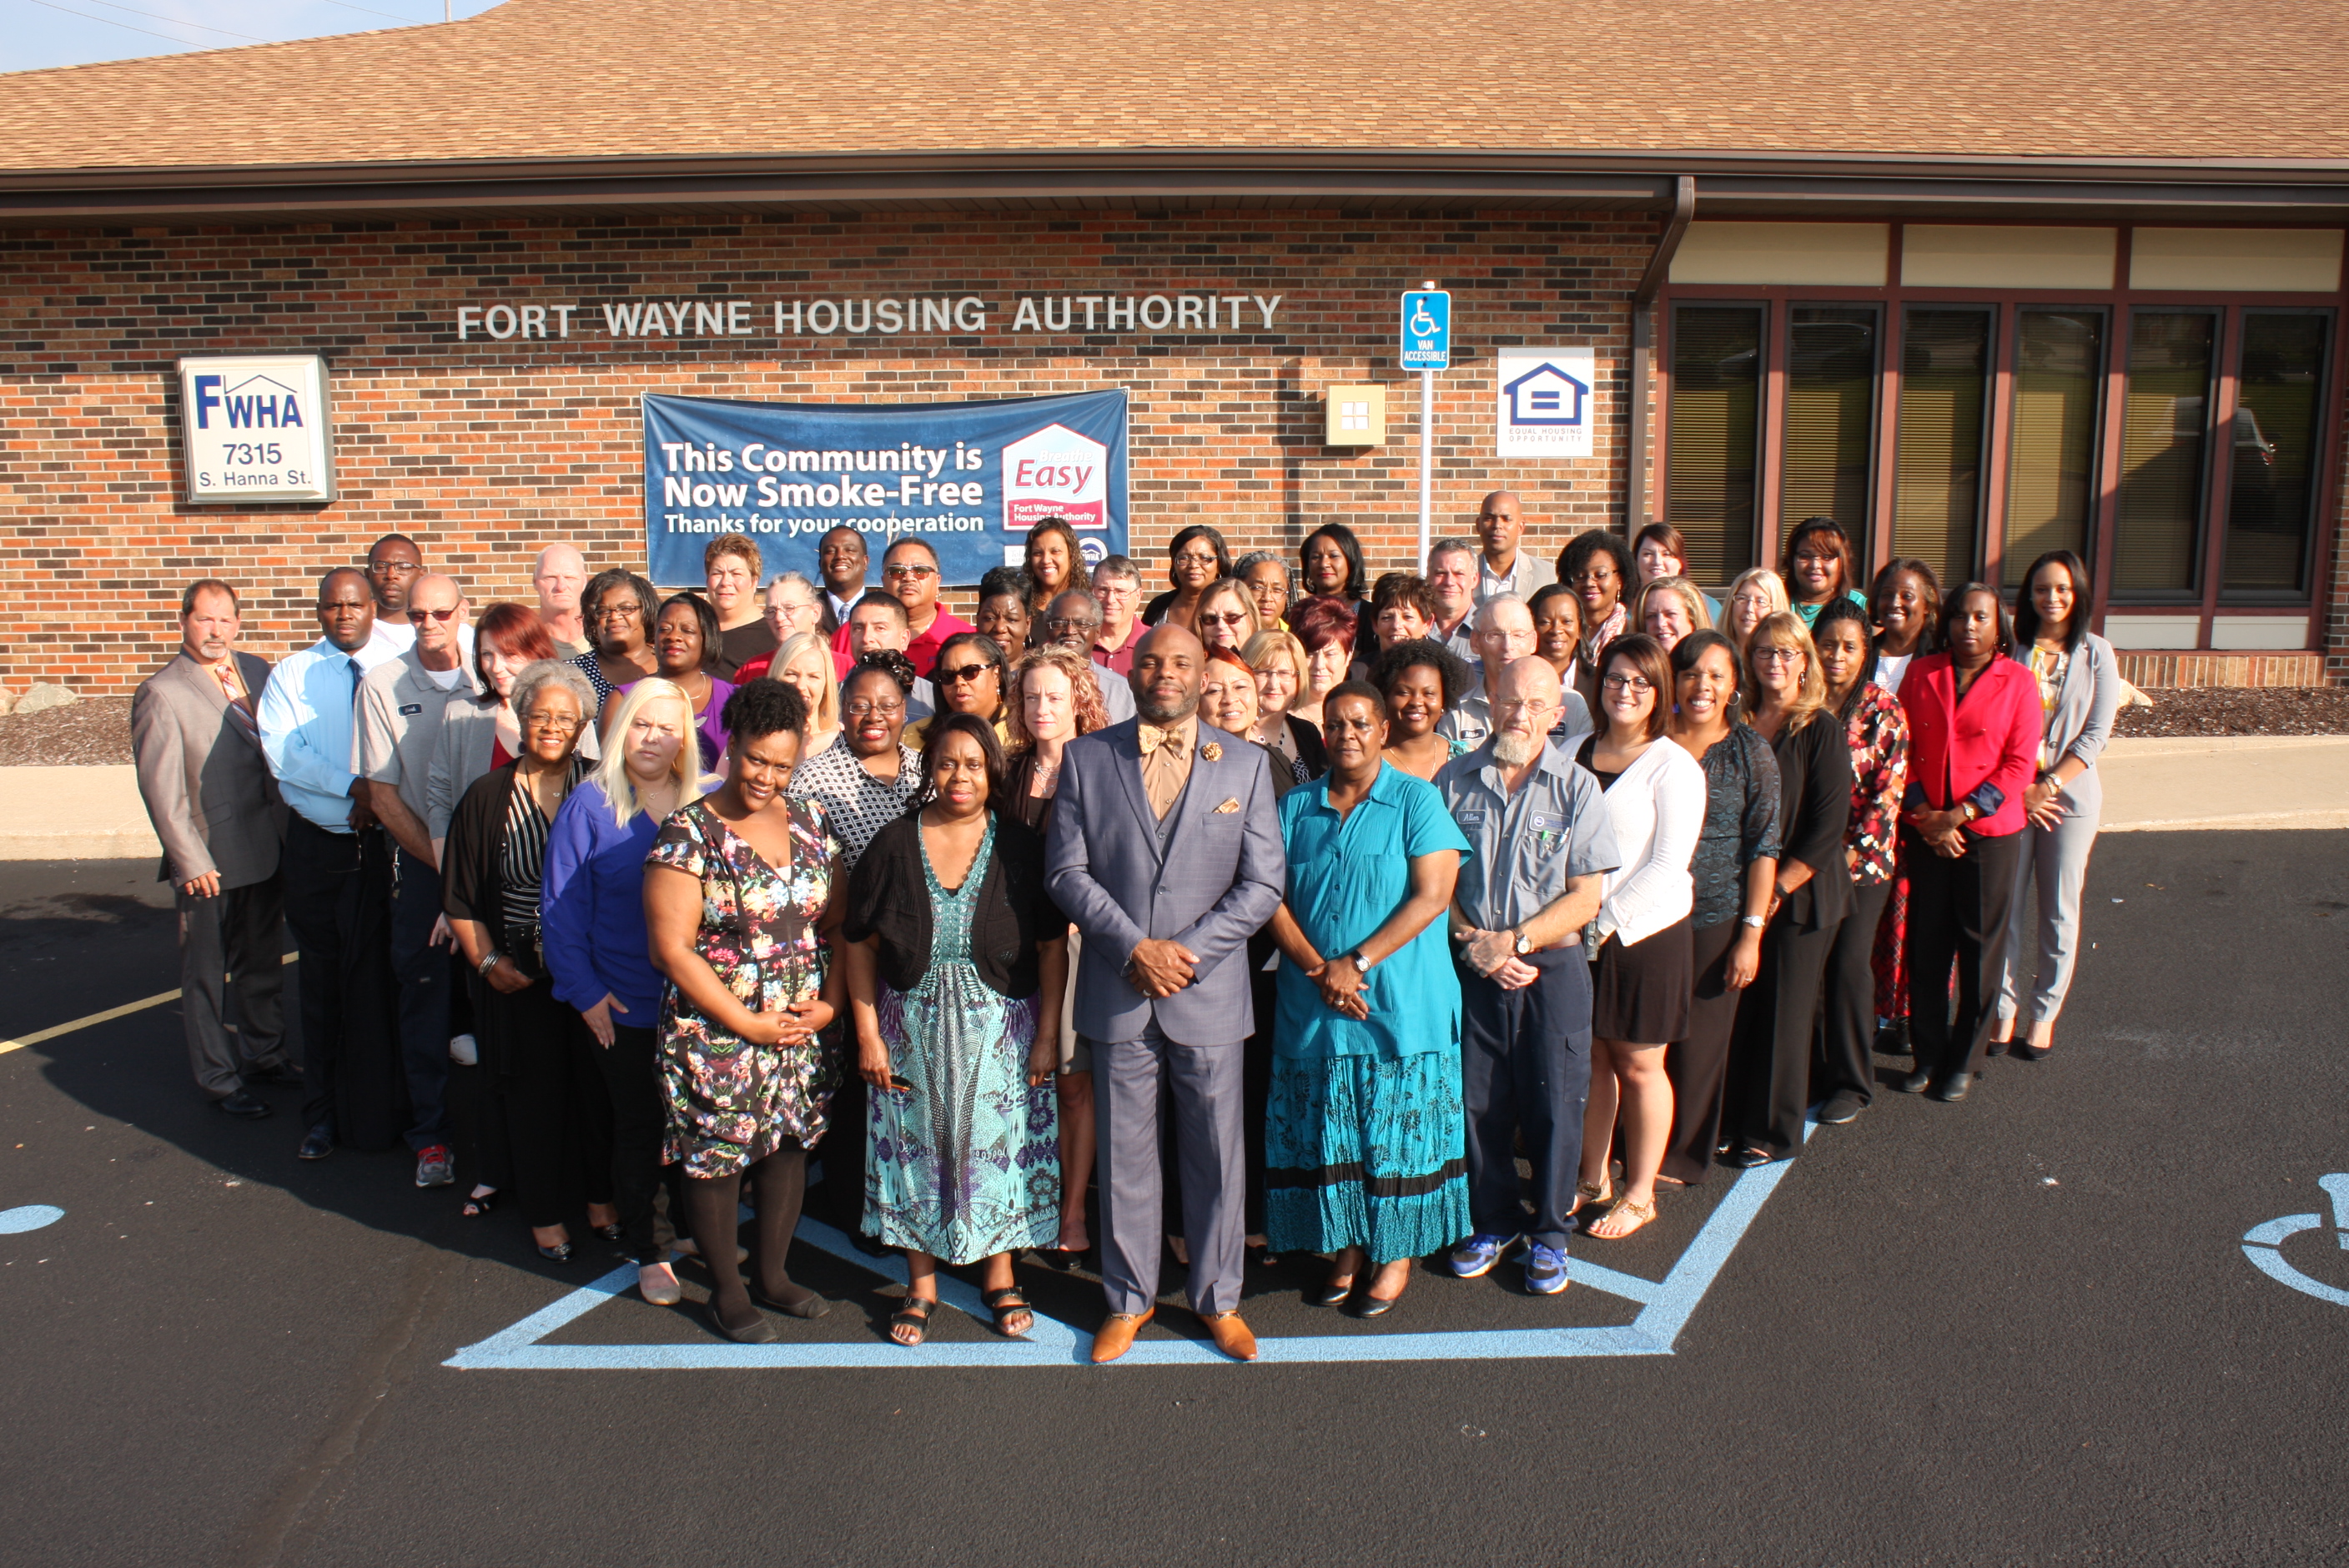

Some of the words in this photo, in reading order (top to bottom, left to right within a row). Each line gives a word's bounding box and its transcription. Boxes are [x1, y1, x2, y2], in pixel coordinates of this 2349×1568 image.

[457, 304, 577, 339] FORT
[601, 300, 752, 337] WAYNE
[773, 296, 986, 334] HOUSING
[1012, 294, 1282, 331] AUTHORITY
[1417, 339, 1434, 350] VAN
[1403, 350, 1446, 362] ACCESSIBLE
[194, 374, 304, 430] FWHA
[222, 442, 282, 465] 7315
[661, 442, 733, 472] This
[741, 441, 948, 479] Community
[956, 441, 983, 470] is
[1039, 450, 1093, 462] Breathe
[199, 471, 216, 487] S.
[224, 470, 279, 486] Hanna
[287, 470, 312, 485] St.
[1014, 459, 1094, 495] Easy
[664, 475, 748, 507] Now
[757, 474, 983, 507] Smoke-Free
[1014, 504, 1033, 513] Fort
[1034, 504, 1064, 514] Wayne
[1054, 511, 1096, 522] Authority
[664, 513, 745, 533] Thanks
[750, 513, 783, 533] for
[787, 518, 841, 538] your
[845, 512, 984, 537] cooperation
[1463, 813, 1480, 822] Allen
